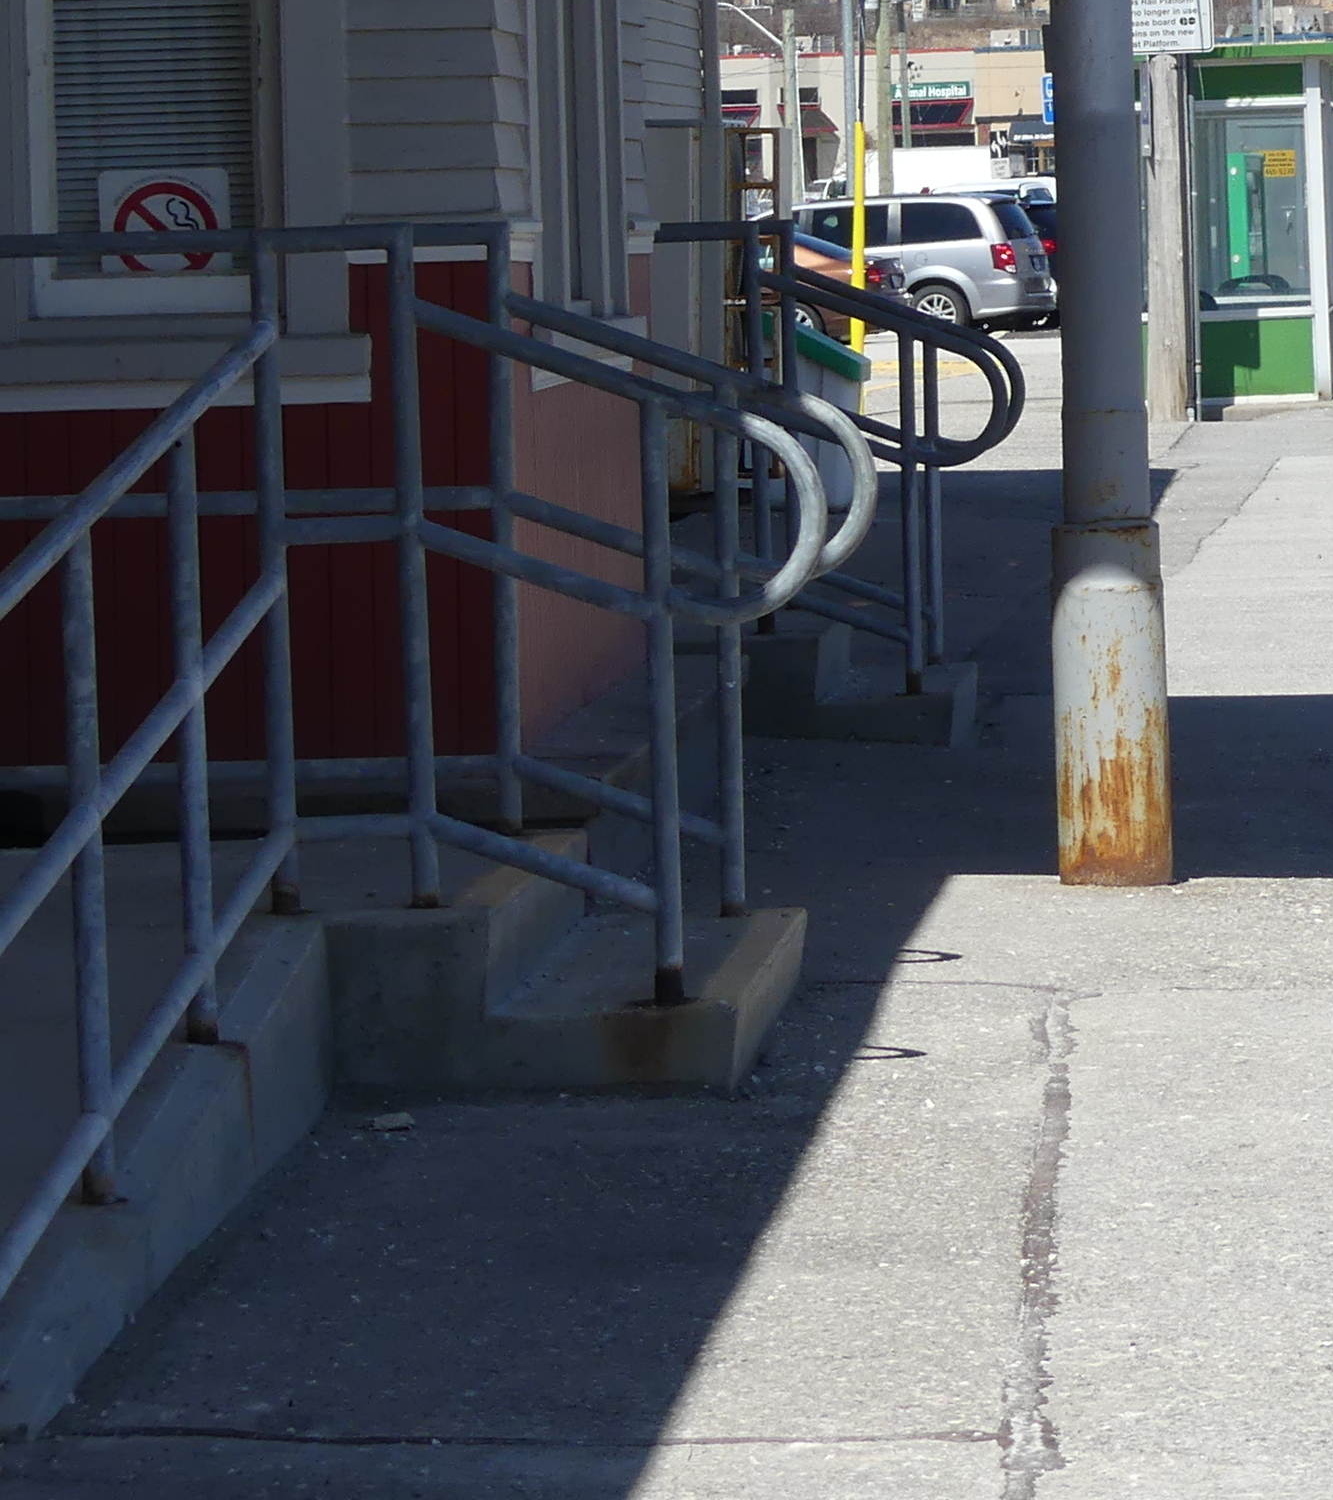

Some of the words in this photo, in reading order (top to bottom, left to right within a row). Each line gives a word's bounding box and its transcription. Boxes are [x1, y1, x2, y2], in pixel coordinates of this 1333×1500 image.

[1143, 8, 1170, 17] longer
[1172, 7, 1180, 15] in
[928, 84, 967, 98] Hospital
